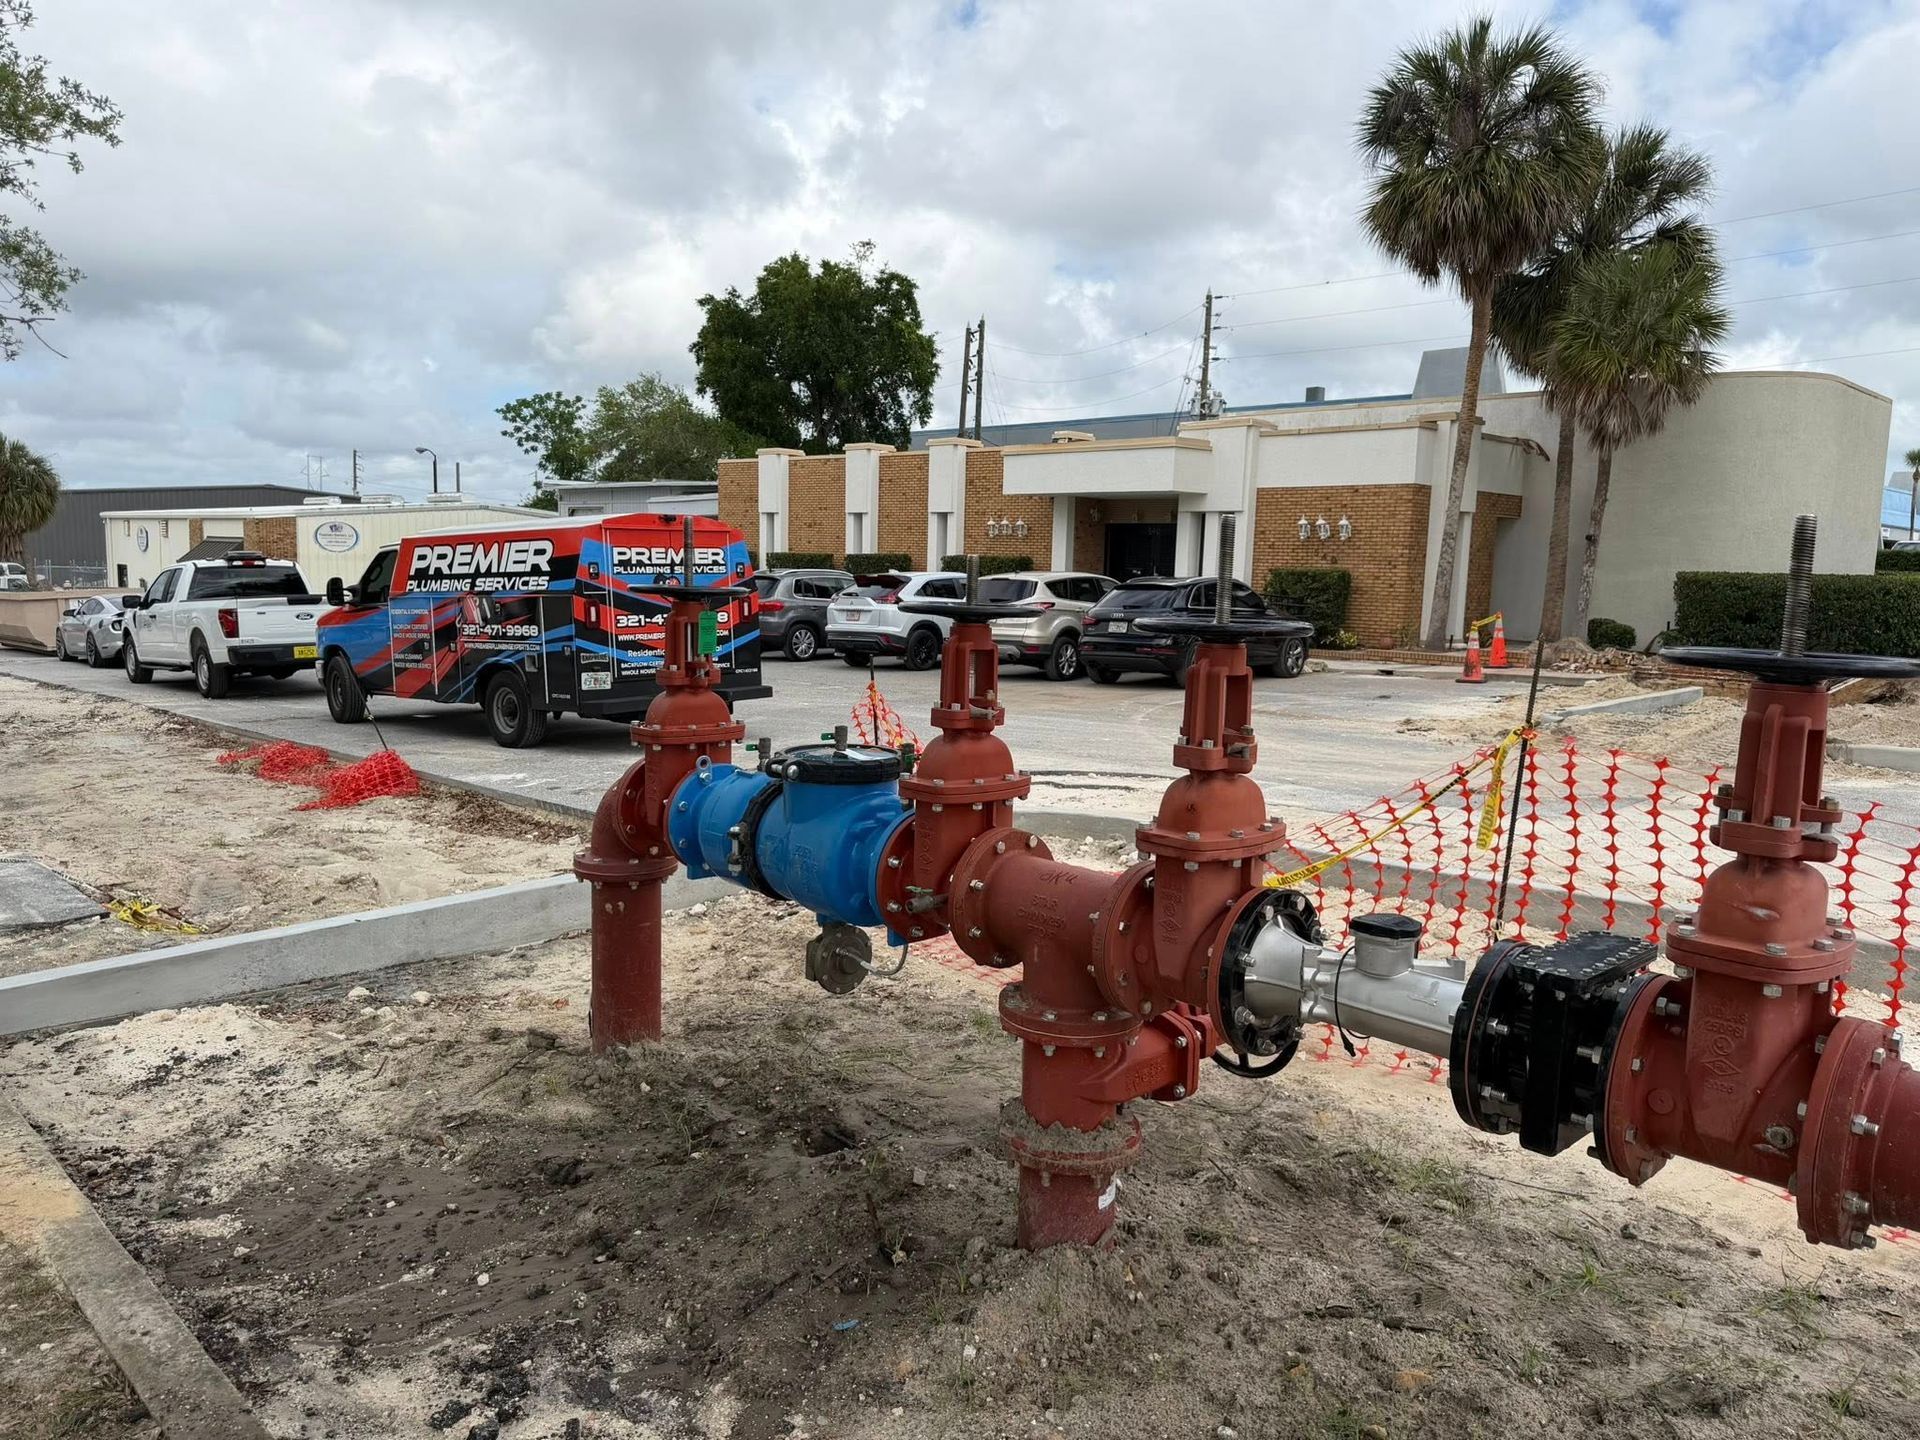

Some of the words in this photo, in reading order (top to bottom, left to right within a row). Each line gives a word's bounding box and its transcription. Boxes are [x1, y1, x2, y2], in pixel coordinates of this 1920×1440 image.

[409, 540, 553, 576] PREMIER
[612, 546, 725, 565] PREMER
[614, 565, 671, 575] PLUMBING
[406, 578, 472, 593] PLUMBING
[474, 576, 550, 591] SERVICES
